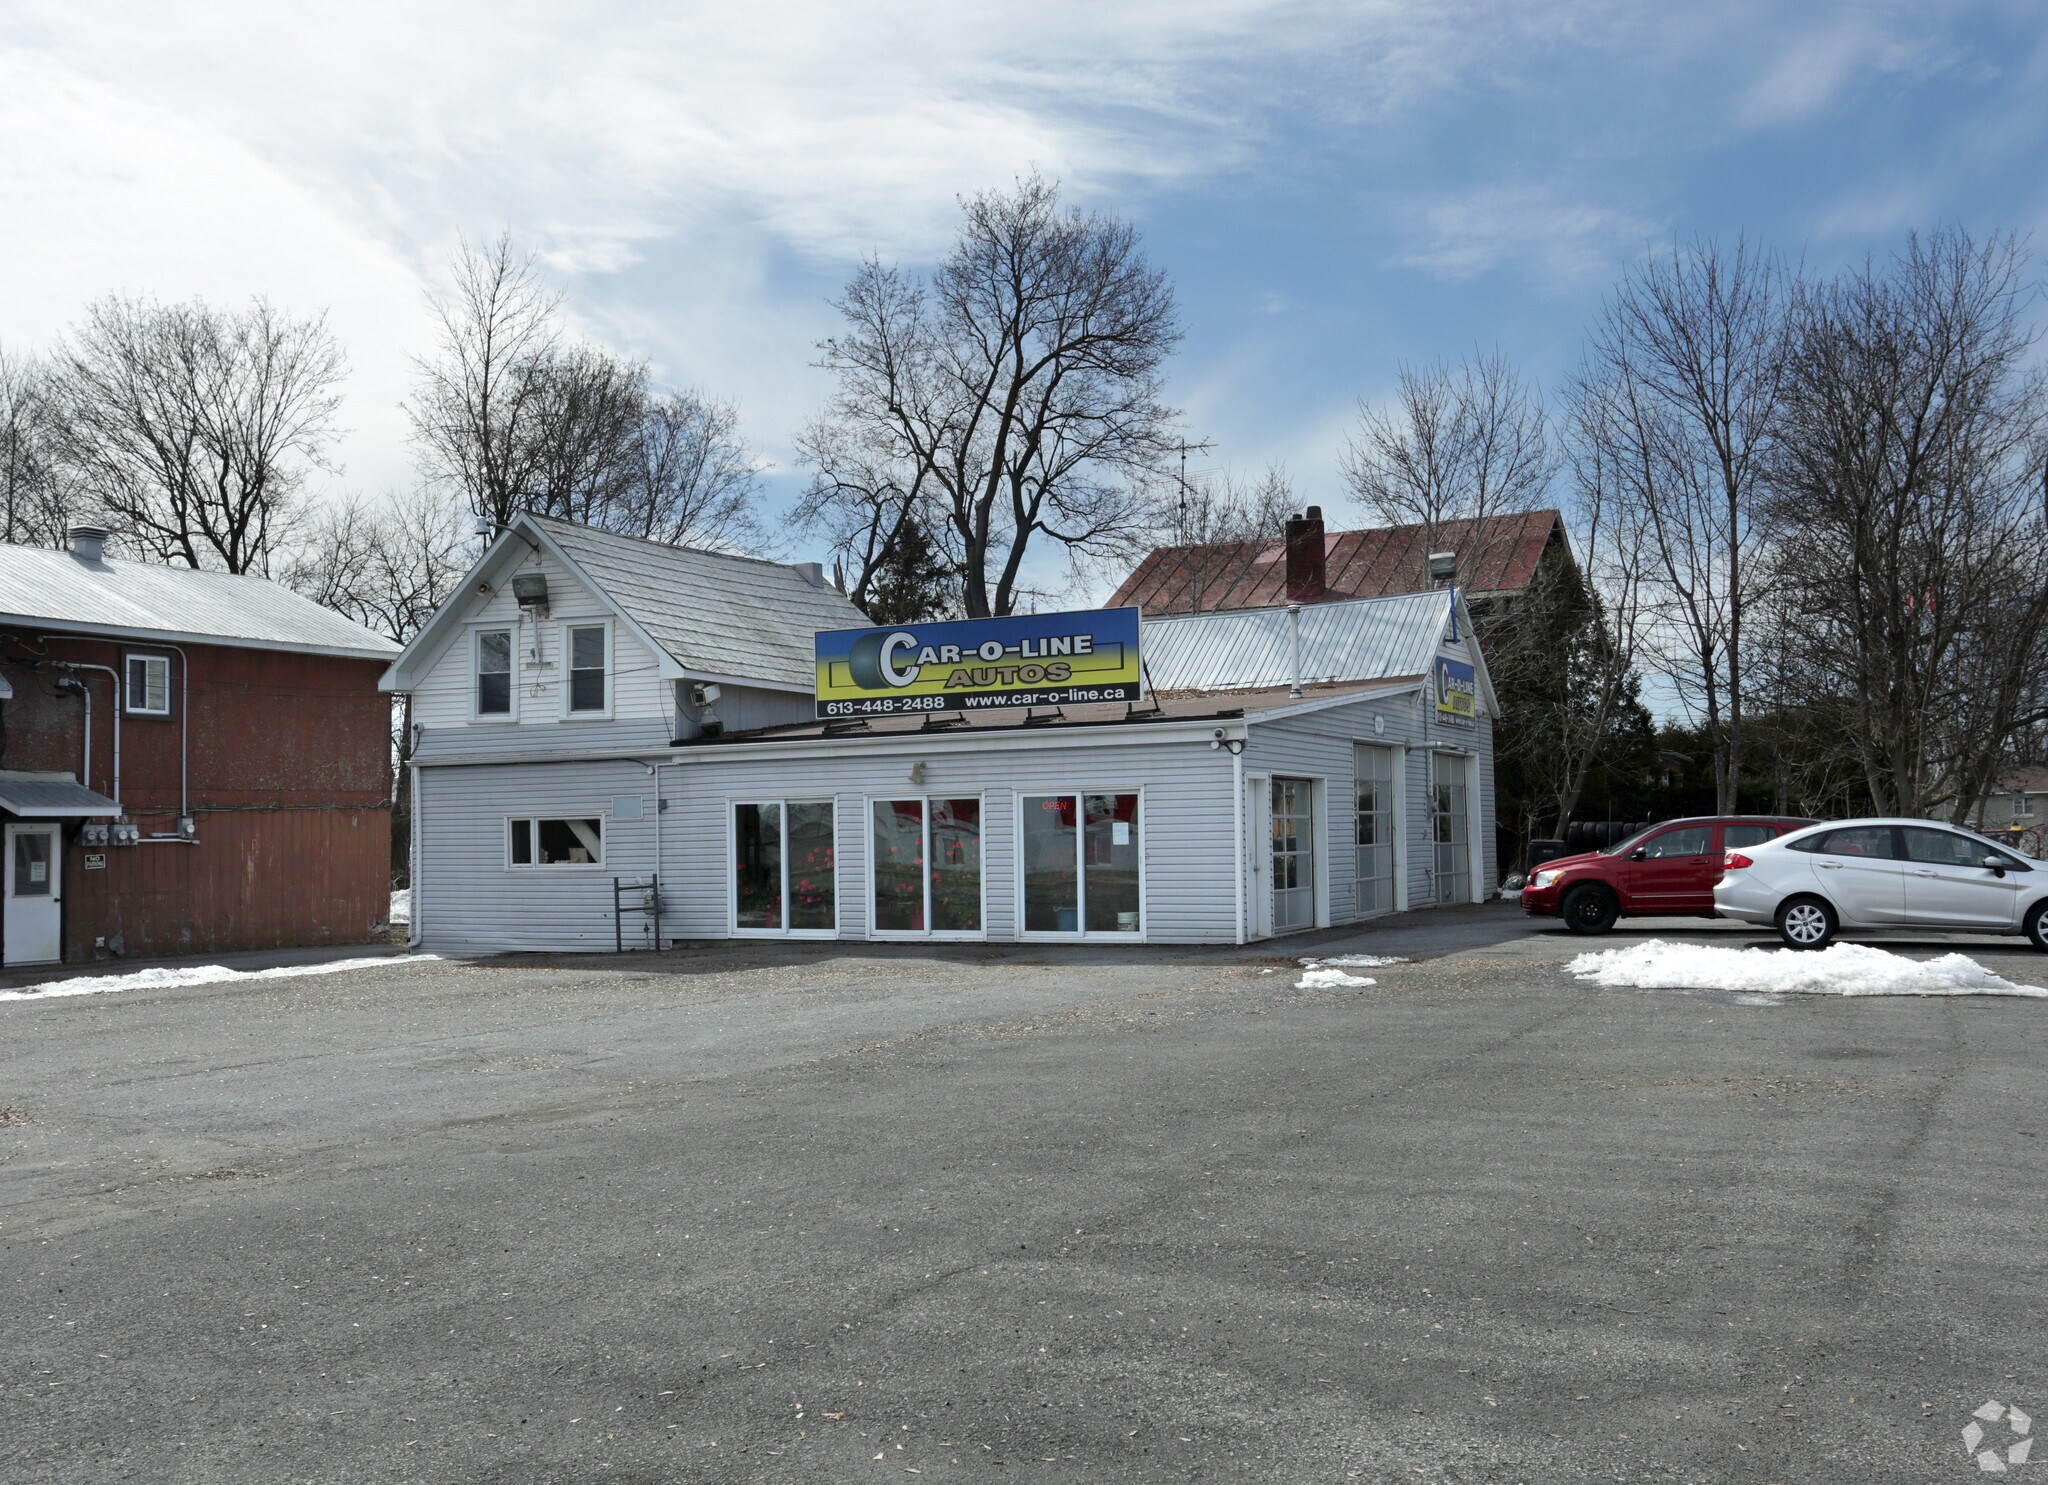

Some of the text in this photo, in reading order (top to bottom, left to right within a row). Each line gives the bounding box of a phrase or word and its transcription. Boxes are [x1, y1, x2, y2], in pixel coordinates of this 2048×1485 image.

[879, 632, 1093, 688] CAR-O-LINE
[944, 662, 1072, 689] AUTOS
[826, 696, 945, 714] 613-448-2488
[965, 688, 1125, 707] www.car-o-line.ca
[1042, 801, 1067, 810] OPEN
